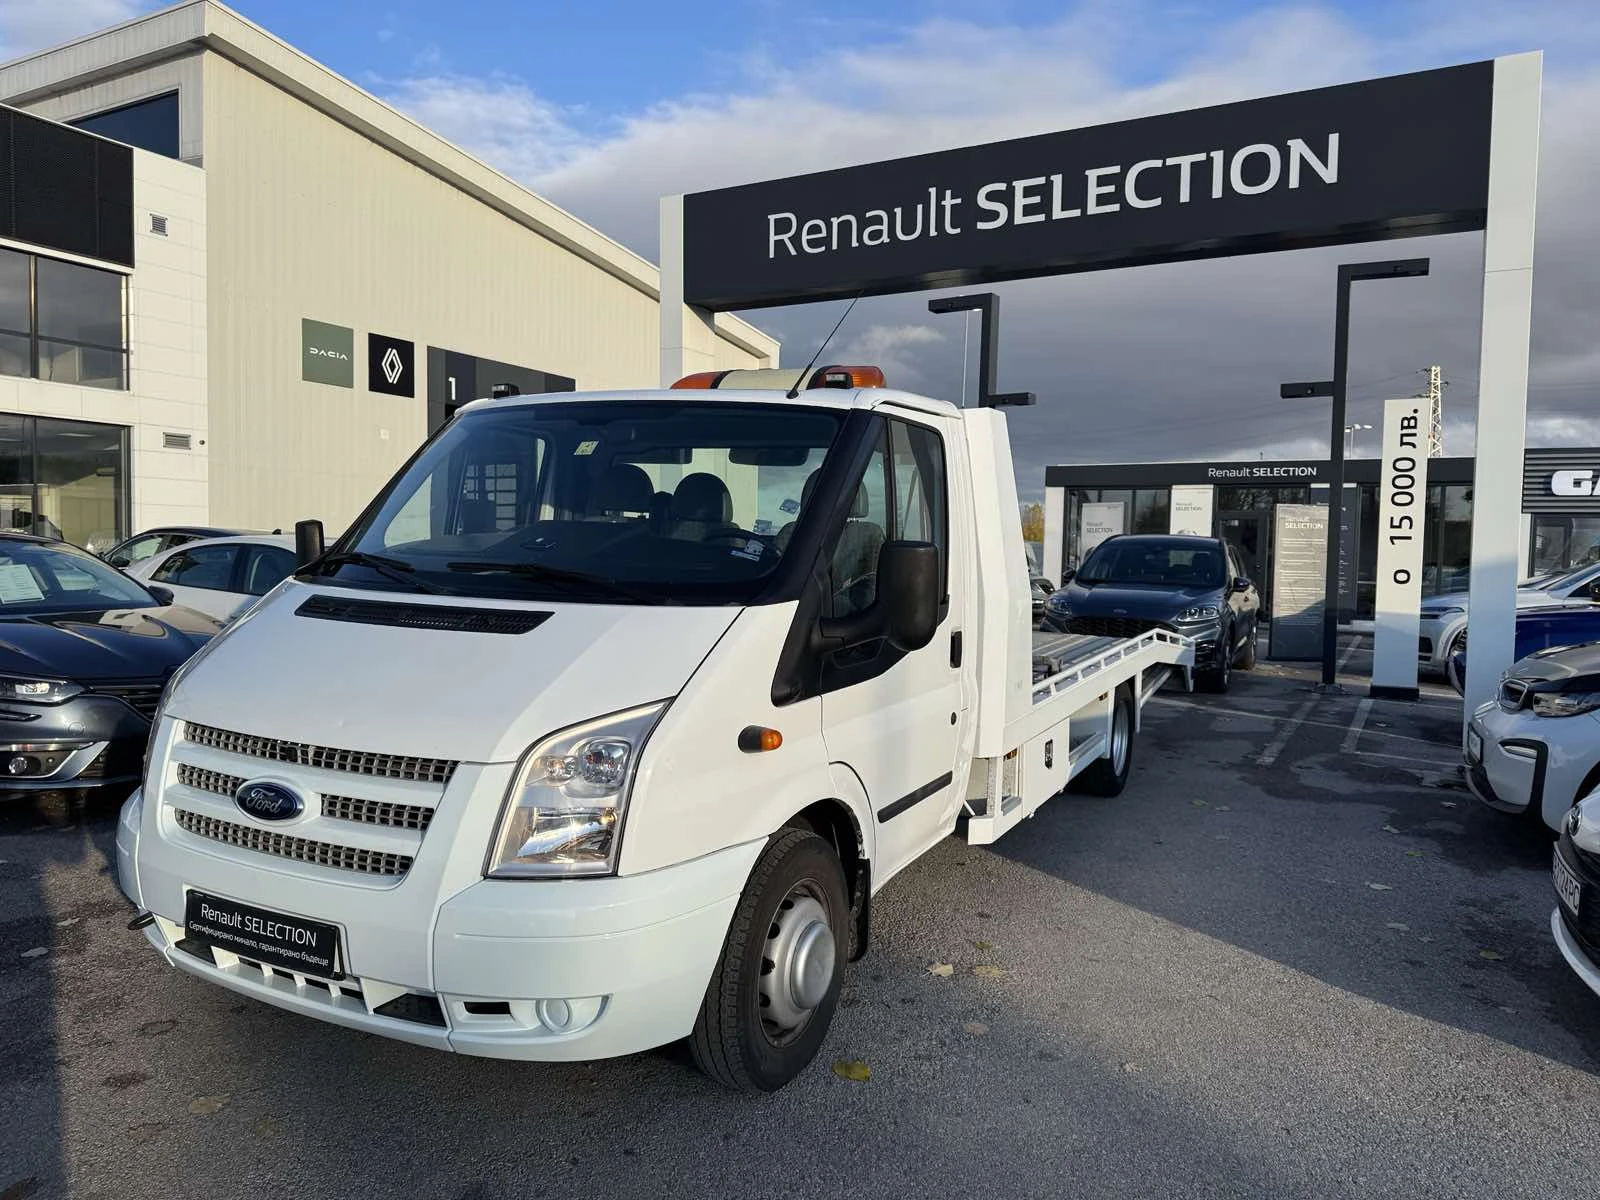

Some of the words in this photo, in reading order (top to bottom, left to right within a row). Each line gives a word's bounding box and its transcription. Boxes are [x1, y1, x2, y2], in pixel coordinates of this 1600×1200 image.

[767, 186, 962, 260] Renault
[976, 132, 1340, 231] SELECTION
[309, 347, 349, 361] DACIA
[448, 376, 456, 400] 1
[1208, 467, 1251, 478] Renault
[1252, 466, 1317, 477] SELECTION
[1551, 469, 1600, 496] G
[246, 788, 283, 814] Ford
[201, 903, 242, 929] Renault
[244, 915, 317, 948] SELECTION
[188, 920, 234, 941] Сертифицирано
[233, 934, 259, 950] минало,
[258, 941, 301, 960] гарантирано
[301, 951, 329, 967] бъдеще
